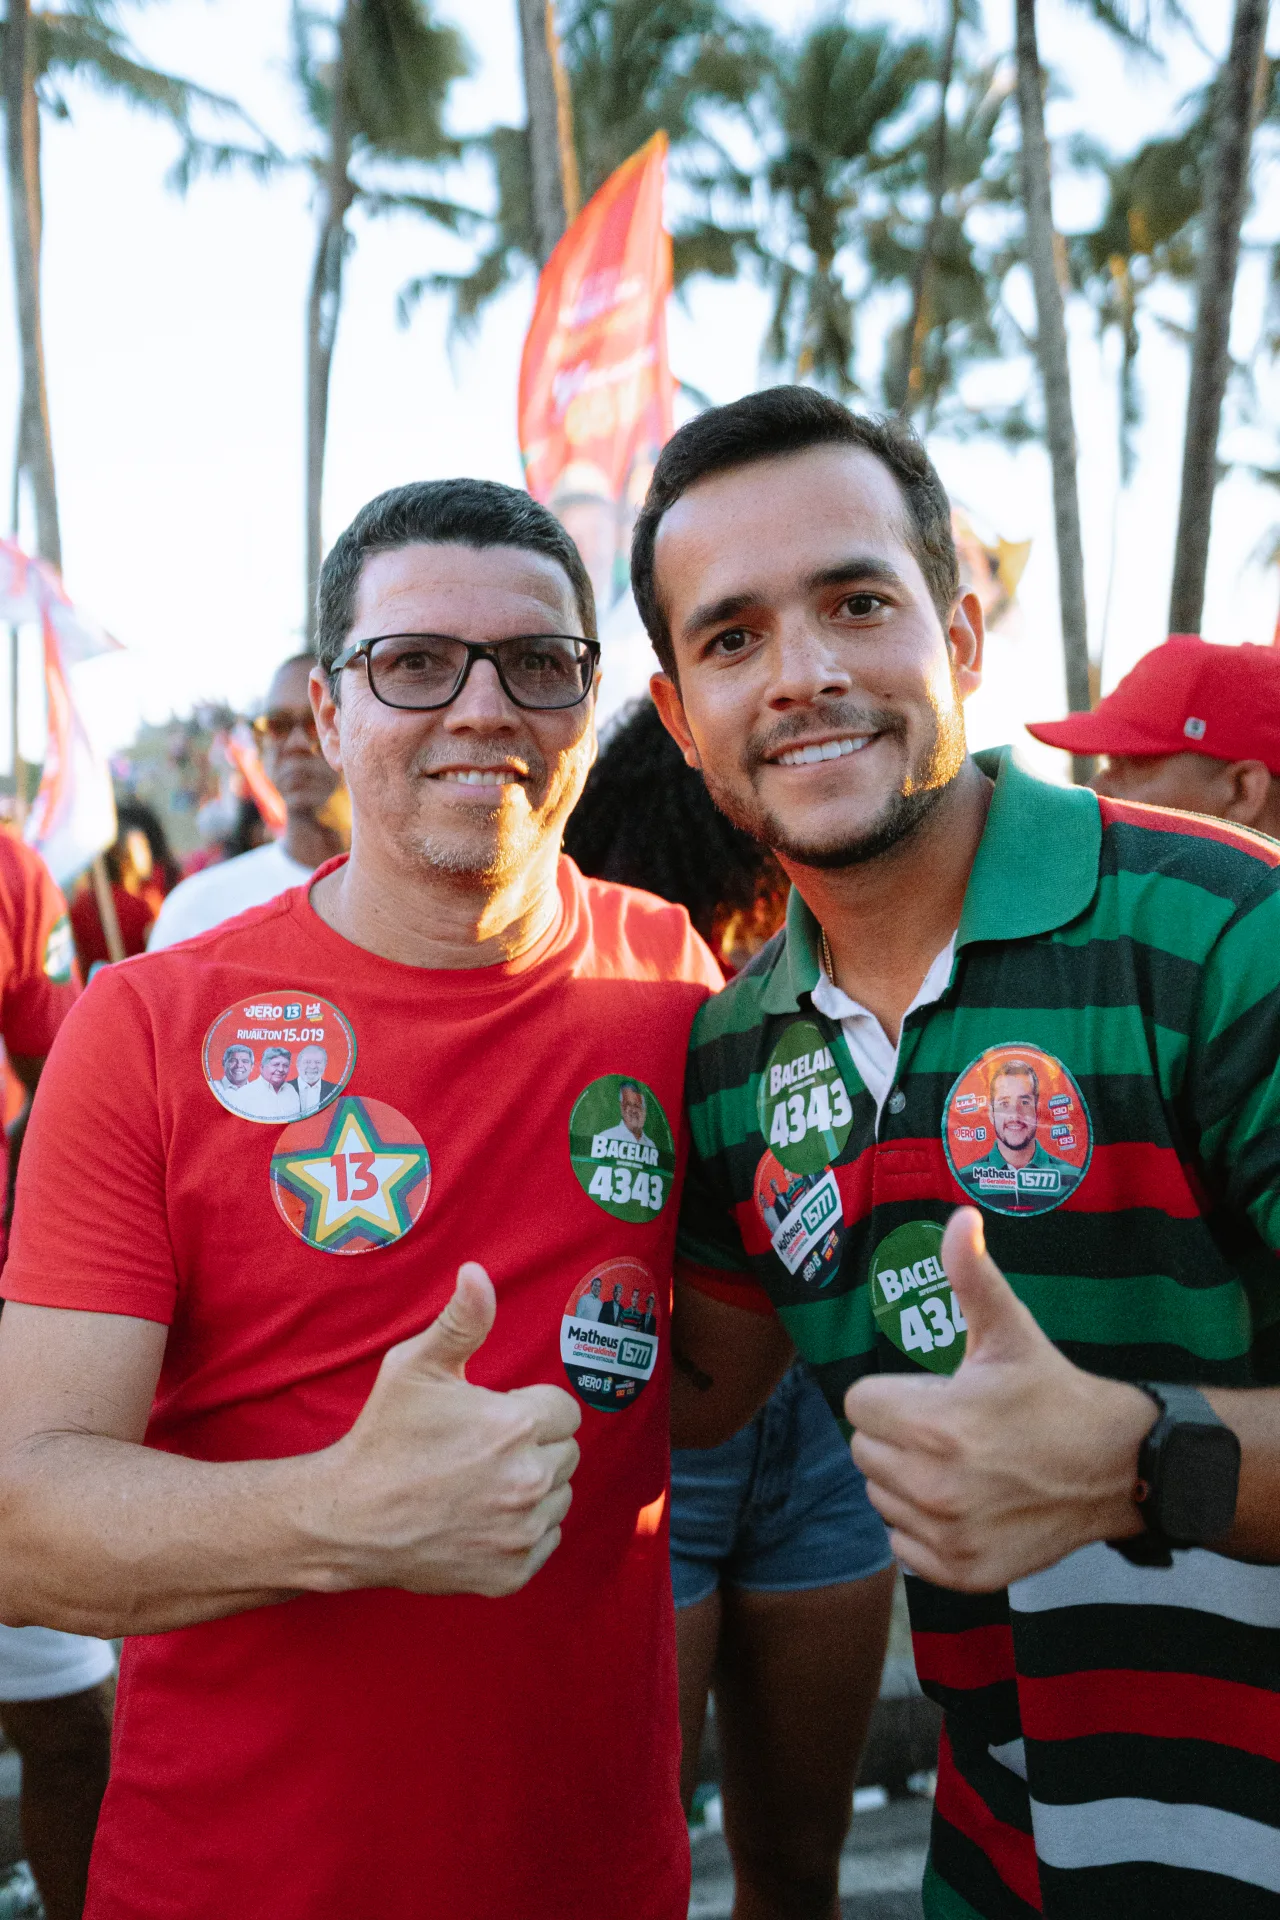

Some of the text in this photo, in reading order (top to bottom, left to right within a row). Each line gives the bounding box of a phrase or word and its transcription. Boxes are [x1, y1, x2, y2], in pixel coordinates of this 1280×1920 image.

[245, 1005, 282, 1018] JERO
[286, 1006, 300, 1018] 13
[237, 1028, 324, 1042] RIVAILTON 15.019
[770, 1077, 853, 1149] 4343
[976, 1129, 985, 1139] 13
[590, 1134, 659, 1166] BACELAR
[330, 1152, 379, 1202] 13
[588, 1166, 664, 1211] 4343
[974, 1168, 1056, 1188] Matheus 15777
[877, 1255, 948, 1304] BACEL
[568, 1325, 651, 1367] Matheus 15777
[582, 1343, 617, 1358] Geraldinho
[578, 1374, 602, 1391] JERO
